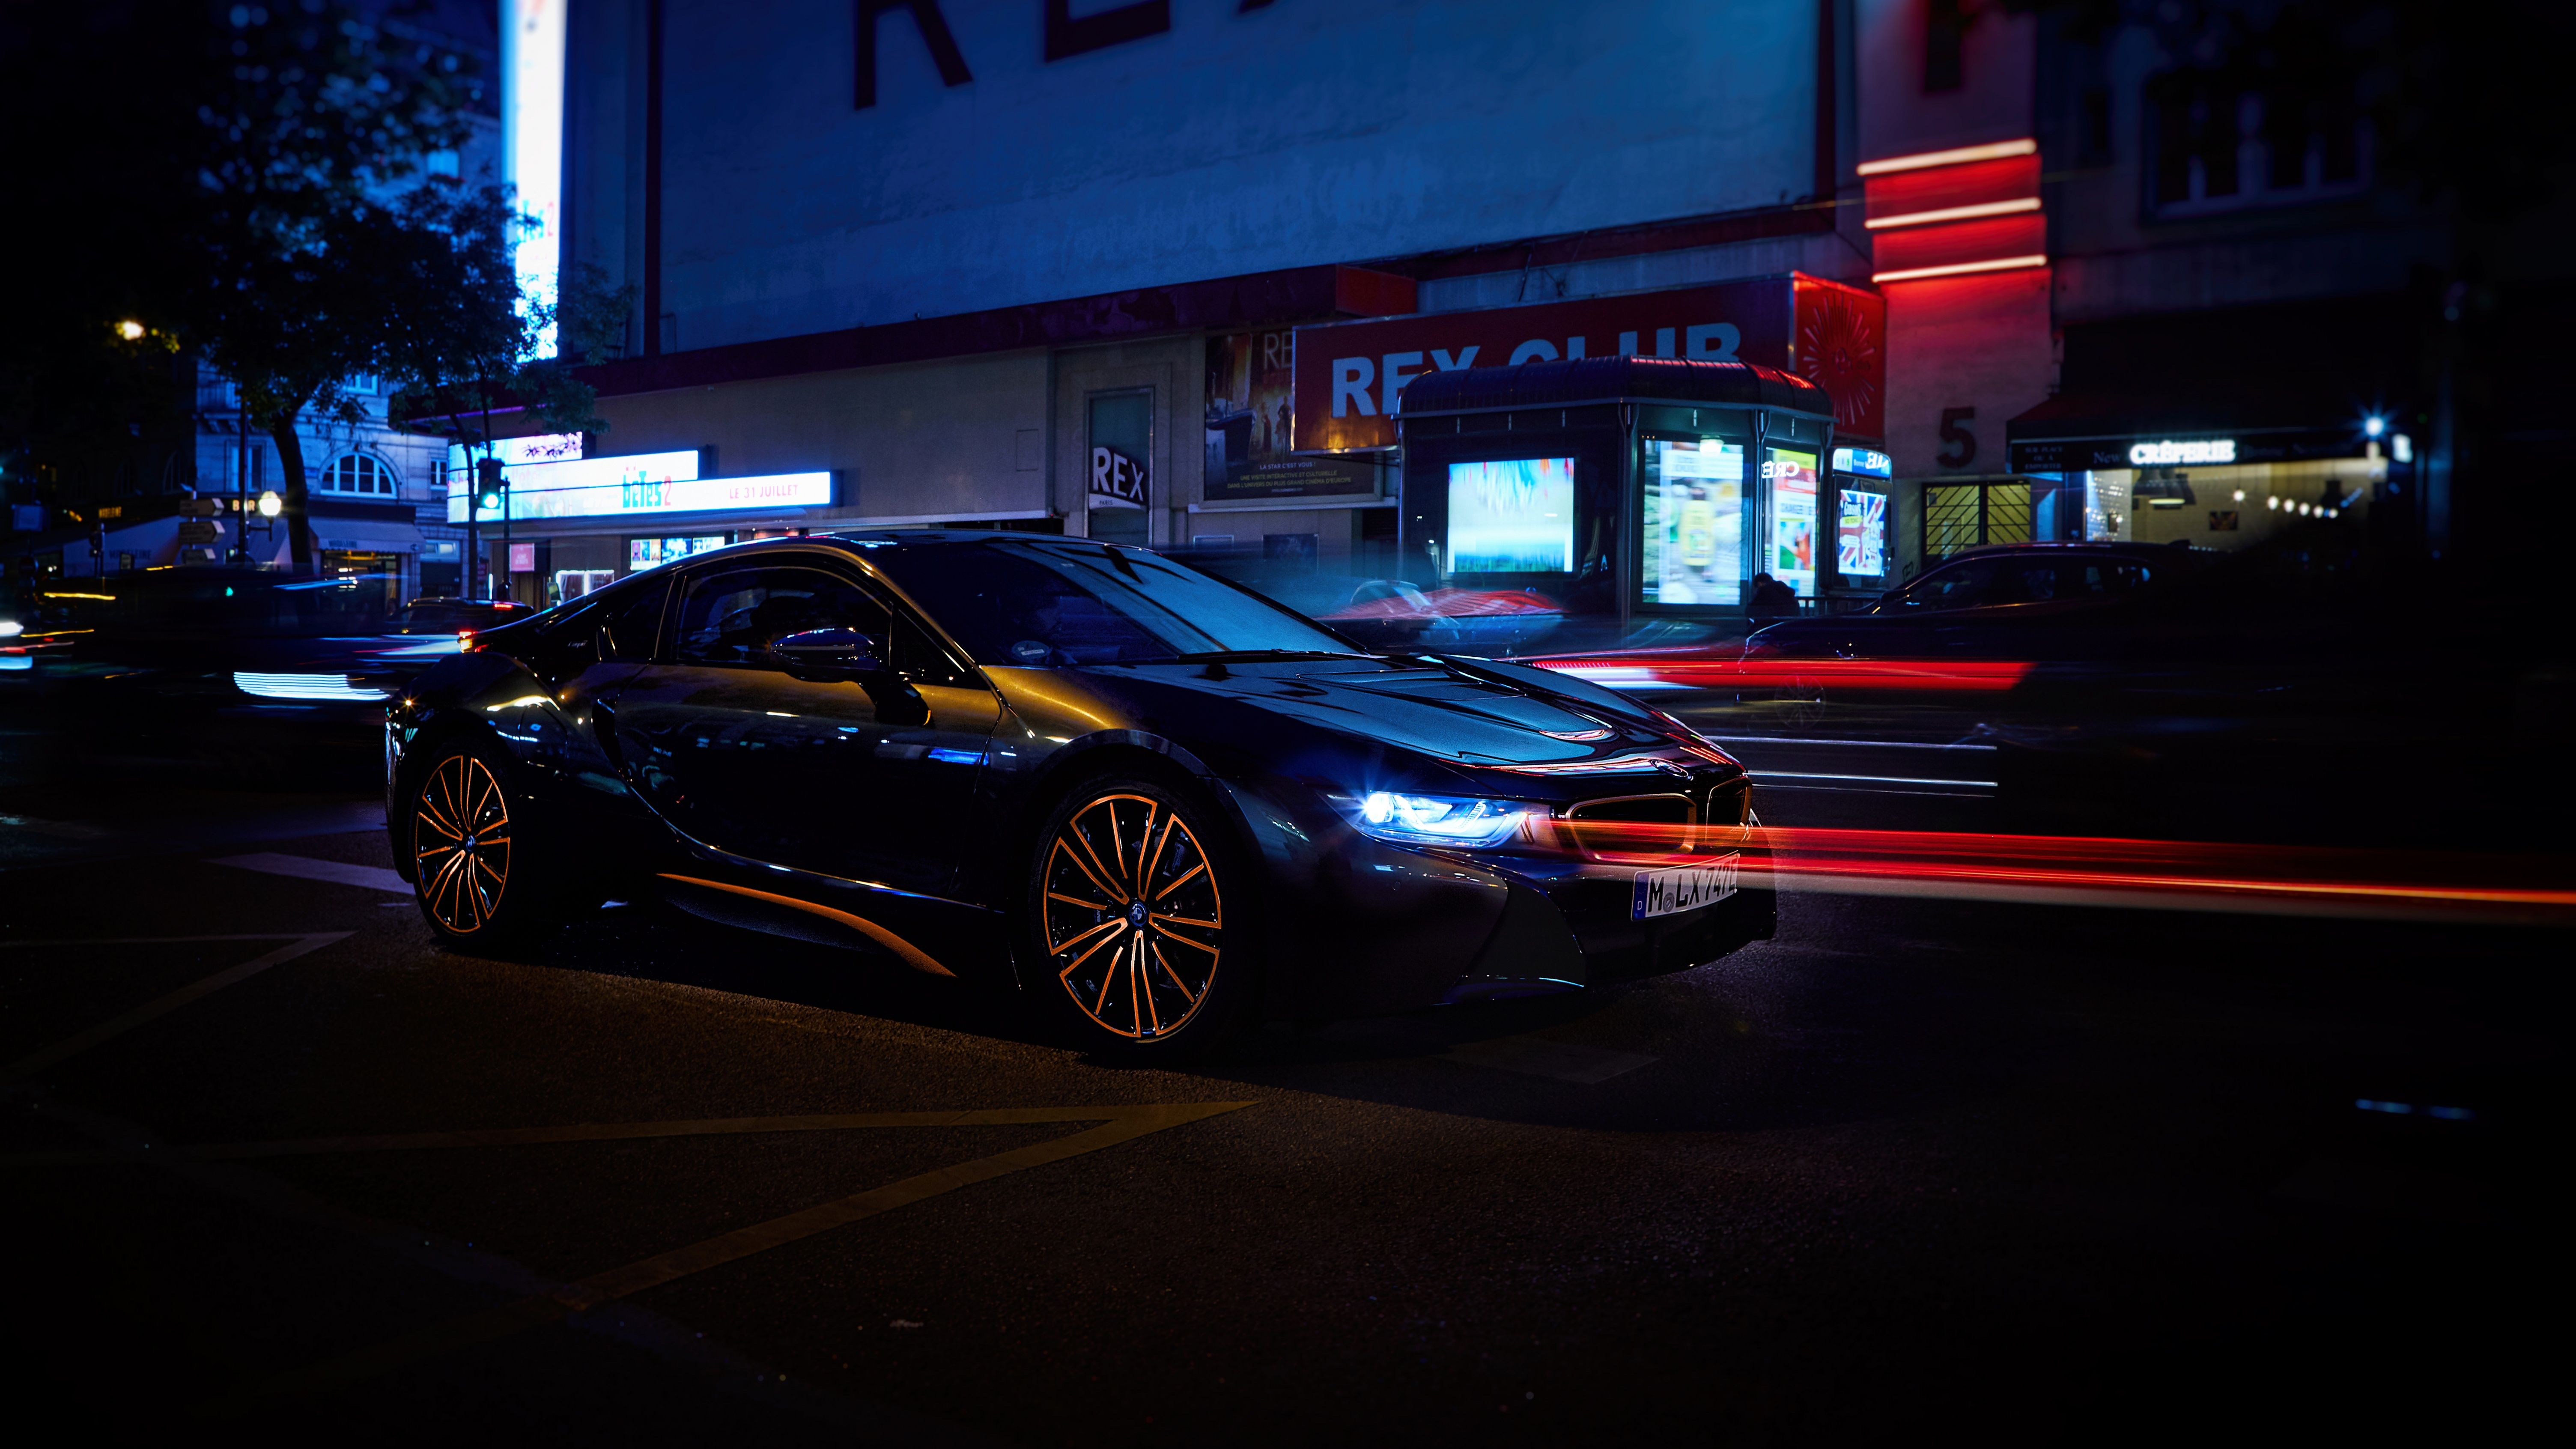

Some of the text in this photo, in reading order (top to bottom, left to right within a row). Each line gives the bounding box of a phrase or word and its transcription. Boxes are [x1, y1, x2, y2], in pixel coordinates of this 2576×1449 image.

[1937, 407, 1974, 468] 5
[2093, 451, 2122, 464] New
[1093, 447, 1144, 501] REX
[730, 484, 798, 499] LE 31 JUILLET
[232, 499, 255, 512] BR
[1648, 877, 1664, 912] M
[1676, 870, 1701, 907] LX
[1637, 901, 1642, 910] D
